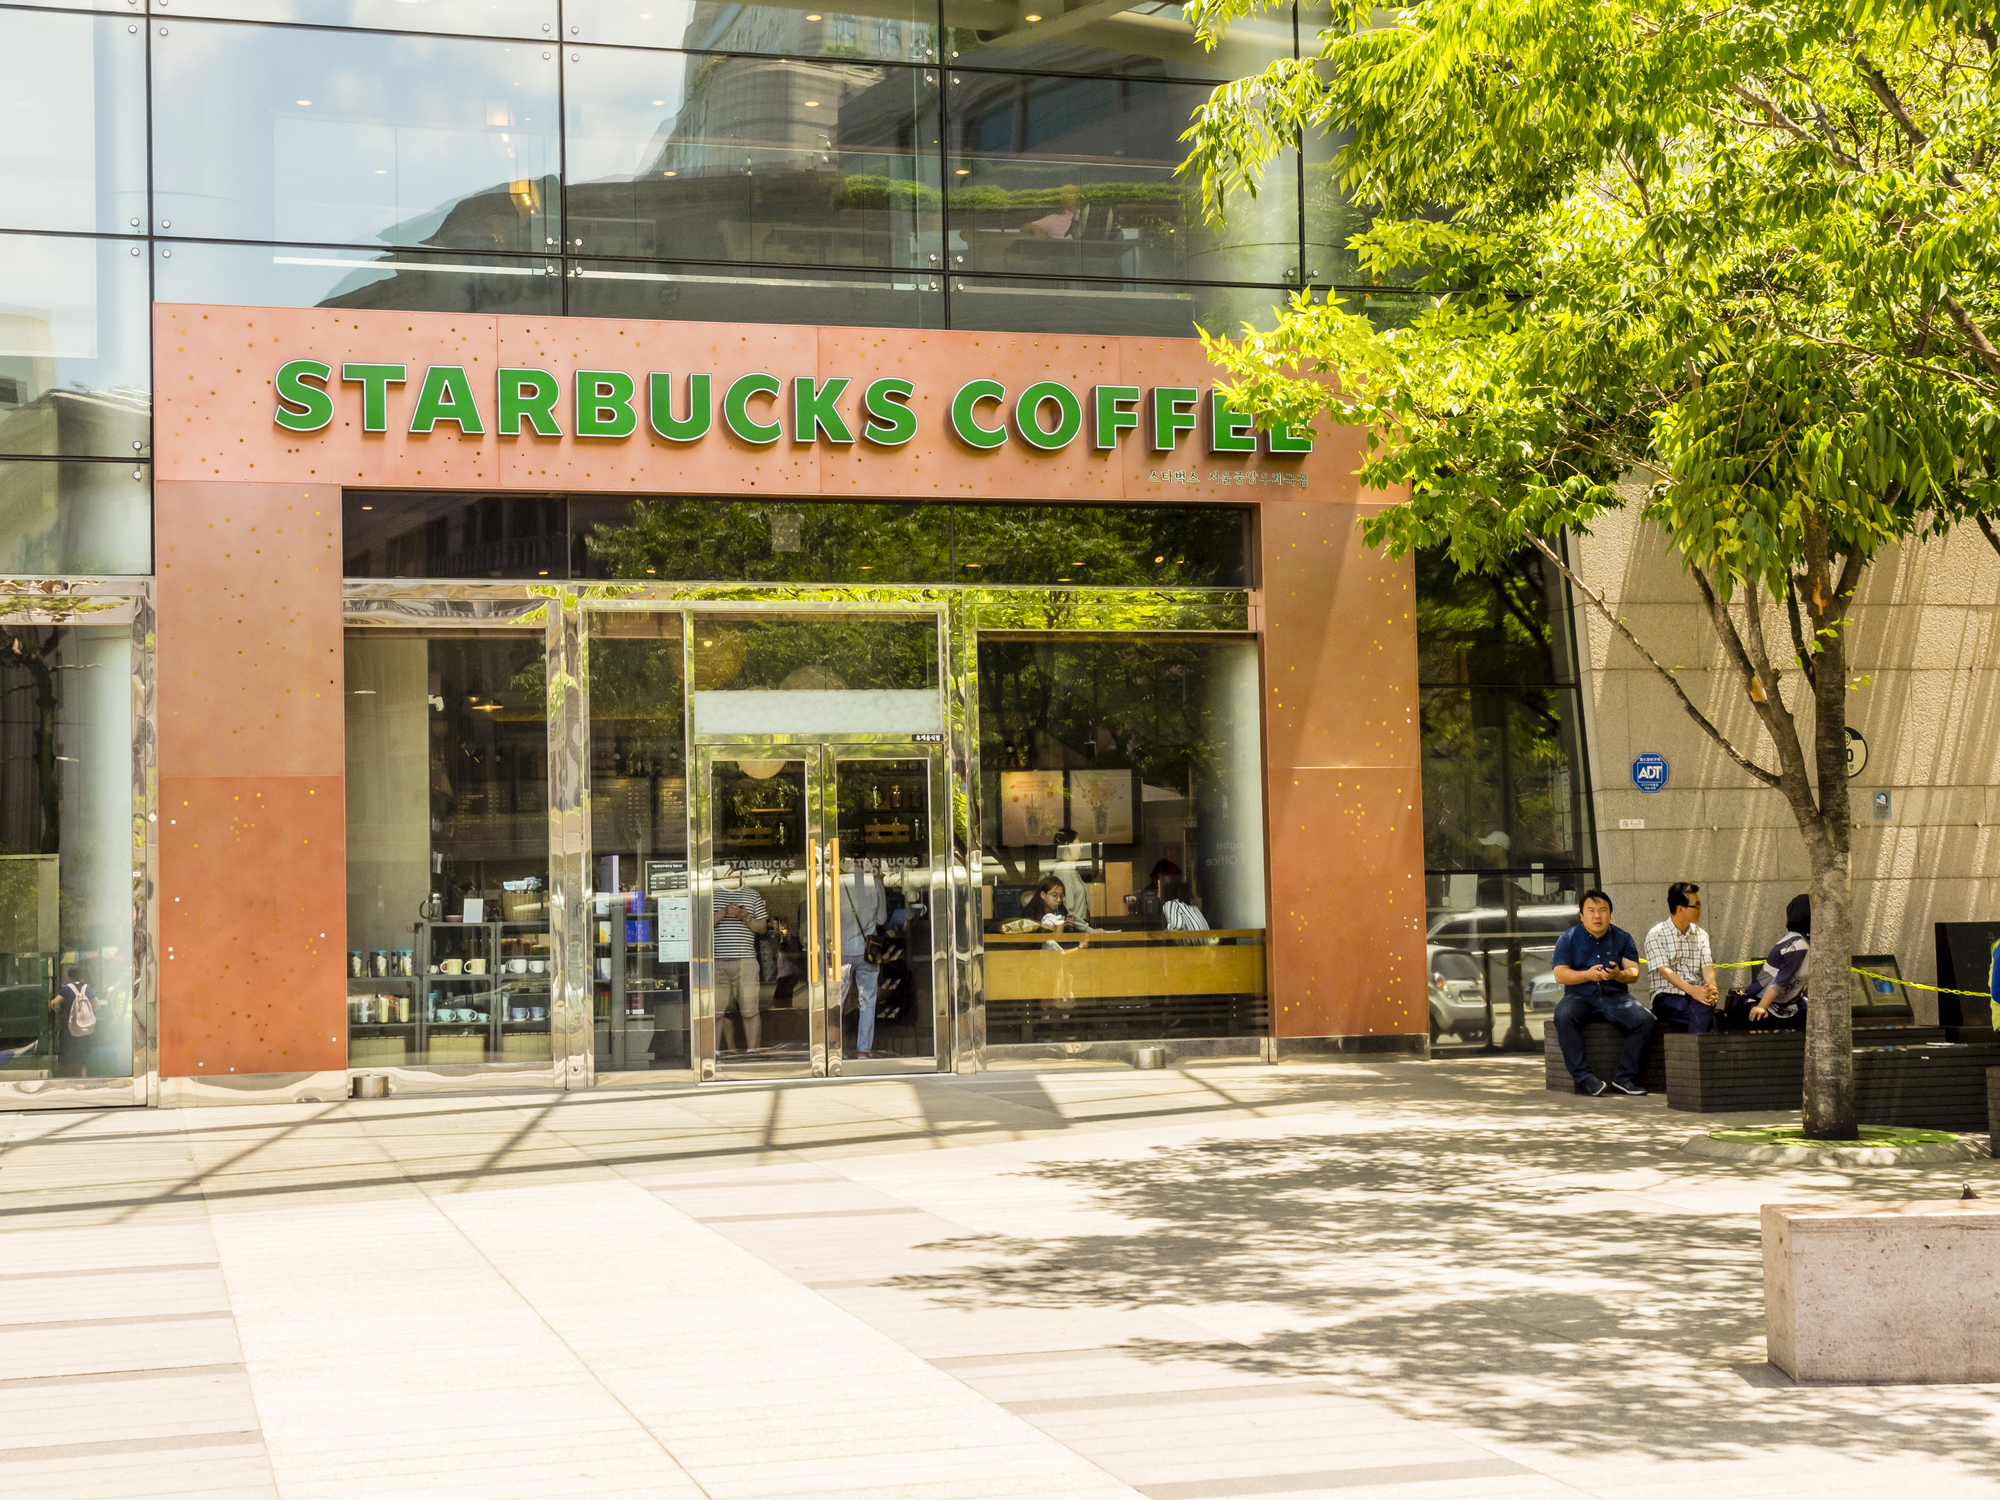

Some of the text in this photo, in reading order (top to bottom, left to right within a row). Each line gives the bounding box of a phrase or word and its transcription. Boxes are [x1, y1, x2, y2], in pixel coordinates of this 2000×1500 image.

[273, 358, 918, 446] STARBUCKS
[1147, 470, 1308, 488] 스타벅스 서울중앙우체국점
[1638, 765, 1662, 779] ADT
[724, 859, 795, 869] STARBUCKS
